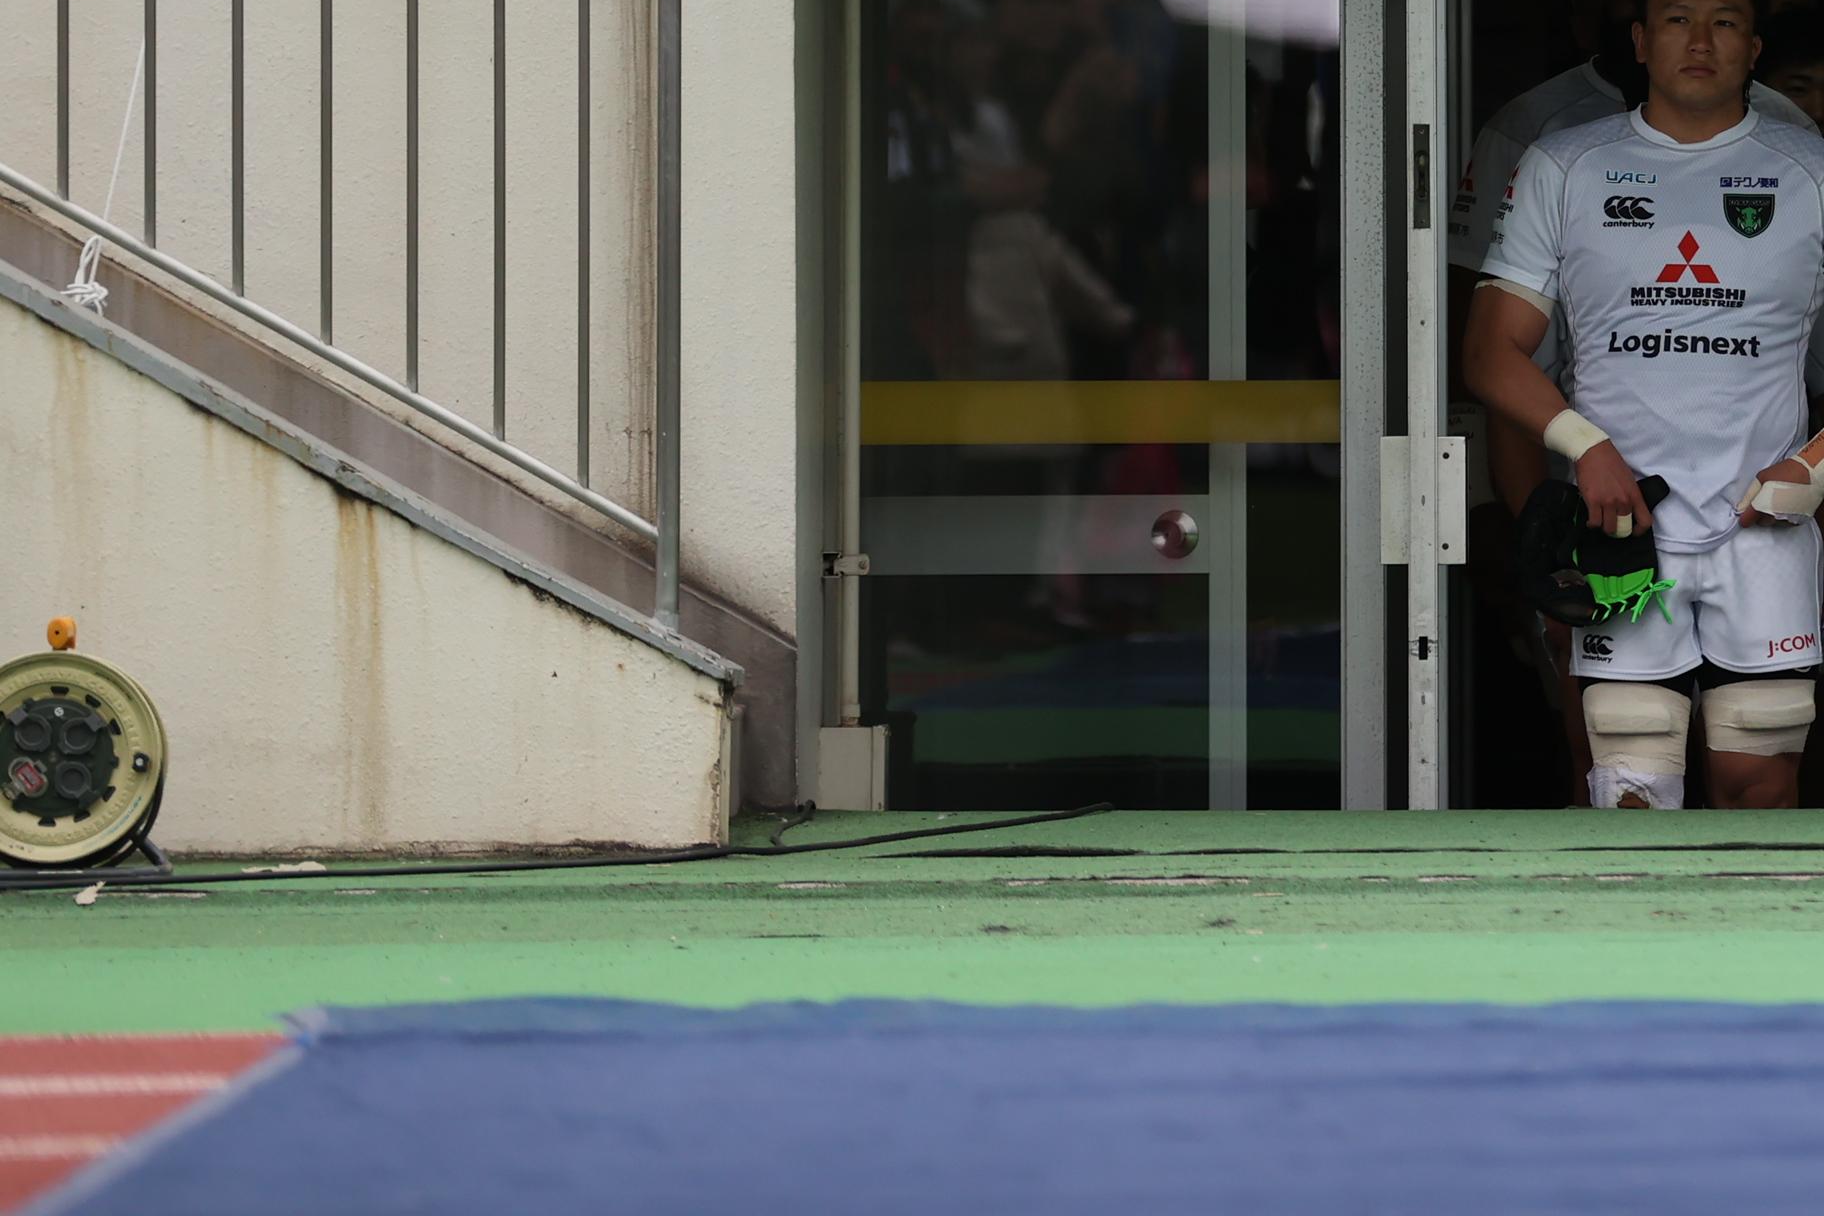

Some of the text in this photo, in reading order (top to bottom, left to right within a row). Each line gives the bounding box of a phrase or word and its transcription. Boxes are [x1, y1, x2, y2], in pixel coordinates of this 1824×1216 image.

[1605, 170, 1657, 184] UACJ
[1602, 219, 1655, 230] canterbury
[1630, 287, 1746, 301] MITSUBISHI
[1630, 298, 1744, 308] HEAVY INDUSTRIES
[1608, 328, 1761, 358] Logisnext
[1767, 632, 1816, 658] J:COM
